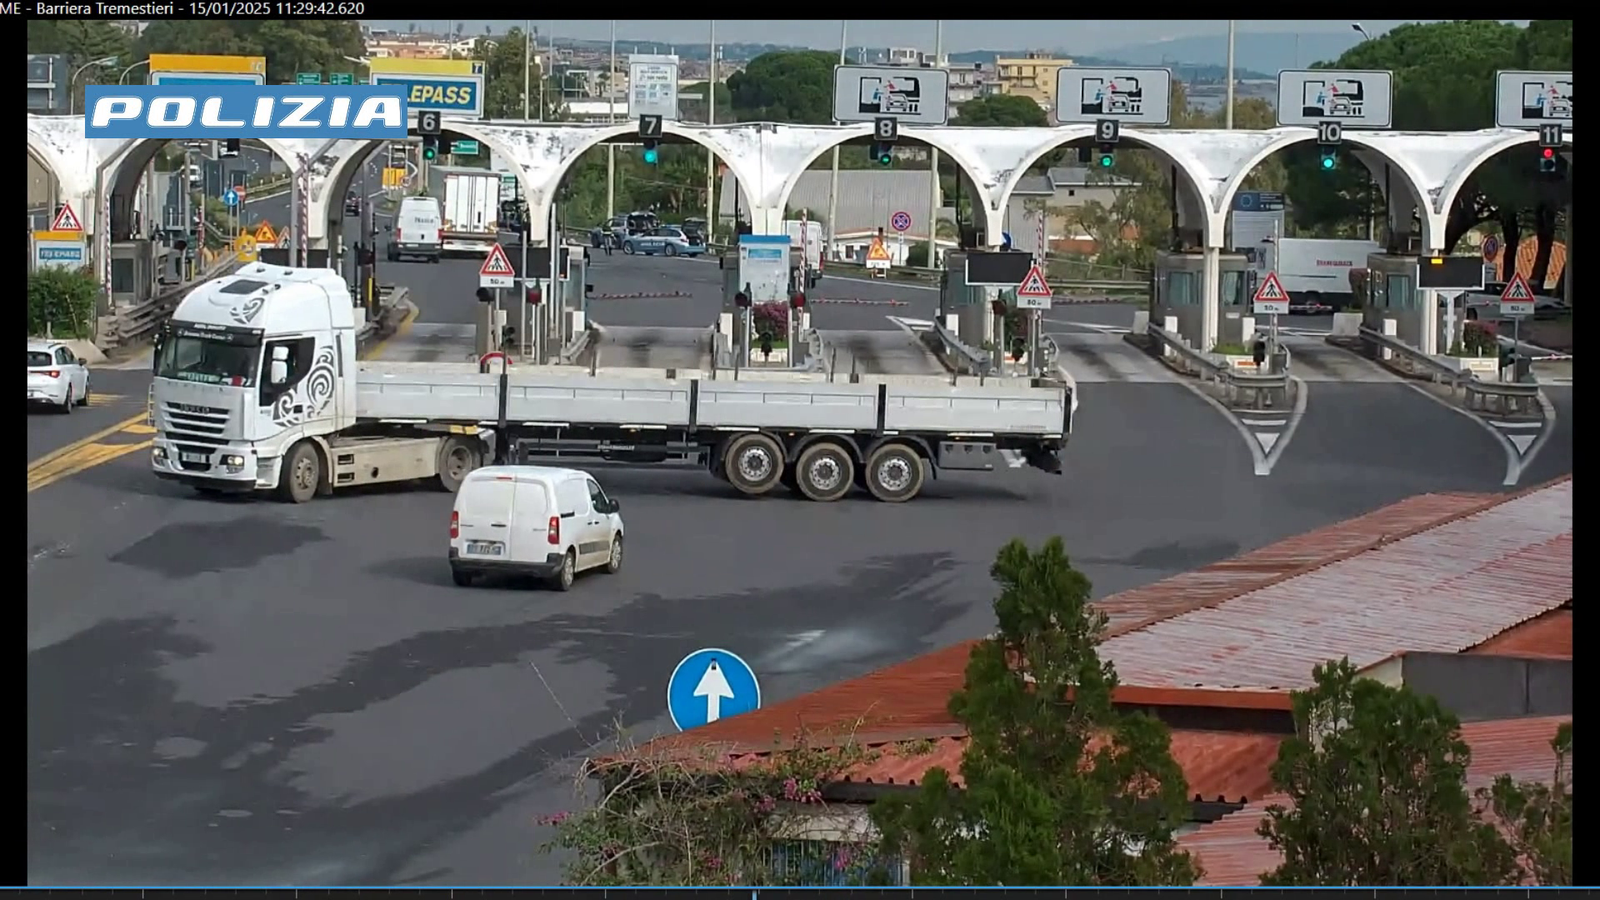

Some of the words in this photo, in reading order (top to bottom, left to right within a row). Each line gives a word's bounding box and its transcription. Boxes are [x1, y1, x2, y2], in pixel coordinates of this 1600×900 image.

[423, 113, 435, 131] 6
[645, 118, 657, 134] 7
[880, 120, 893, 137] 8
[1102, 121, 1114, 138] 9
[1319, 123, 1340, 141] 10
[1543, 126, 1559, 143] 11
